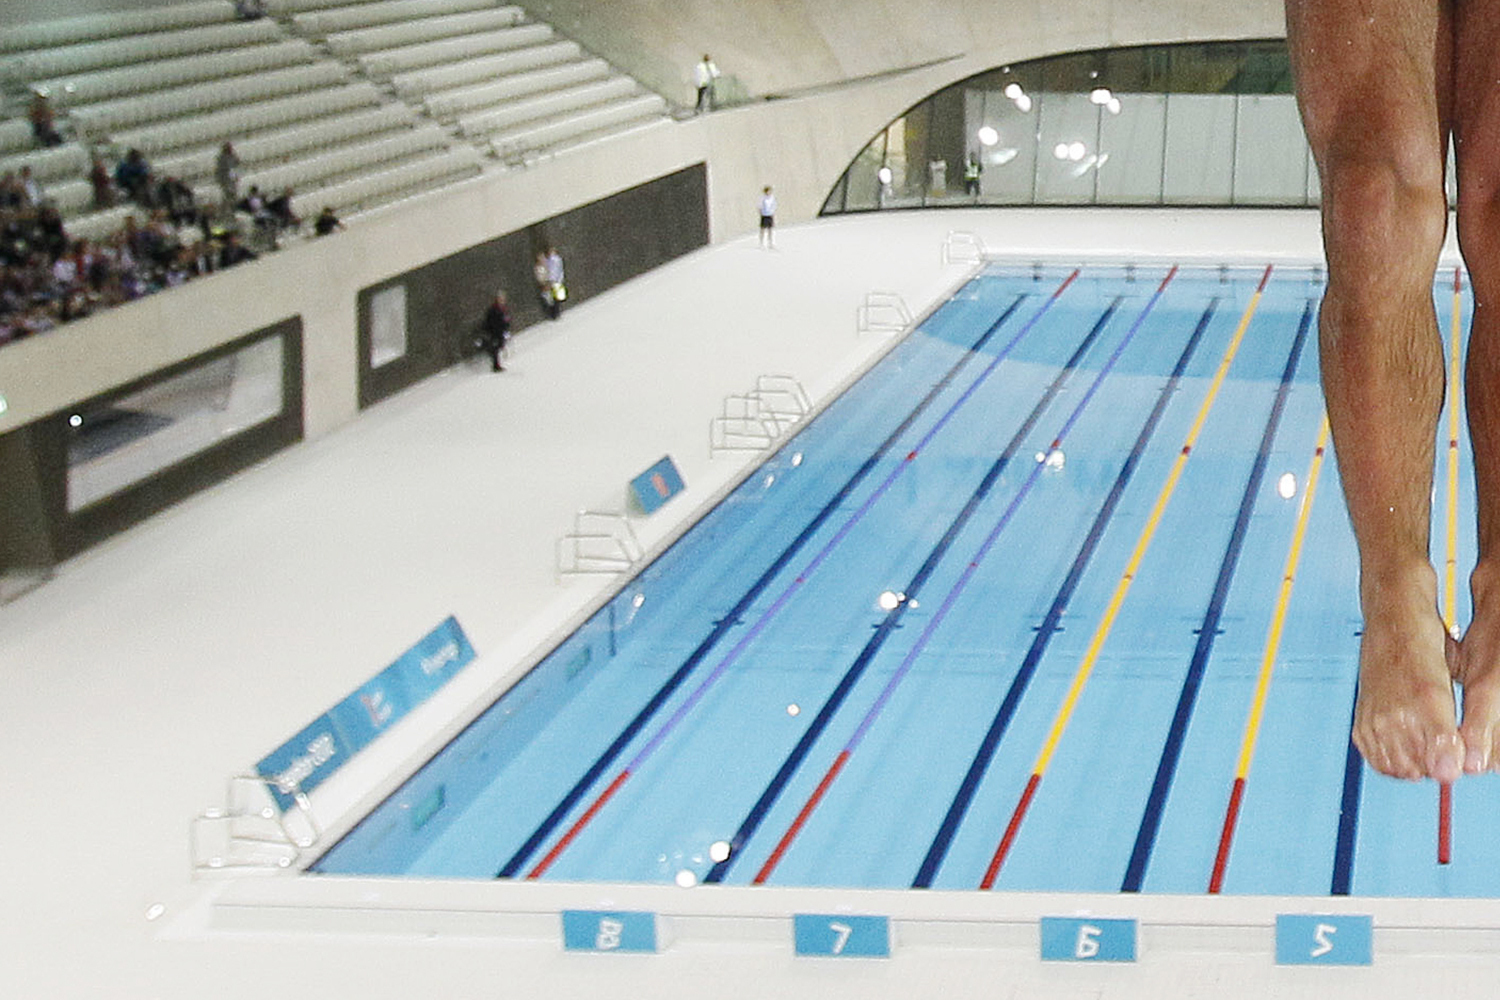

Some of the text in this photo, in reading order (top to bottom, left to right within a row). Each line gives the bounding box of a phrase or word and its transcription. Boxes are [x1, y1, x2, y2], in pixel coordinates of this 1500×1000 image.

[596, 918, 622, 951] 8
[829, 922, 853, 955] 7
[1075, 926, 1101, 958] 6
[1310, 924, 1336, 957] 5
